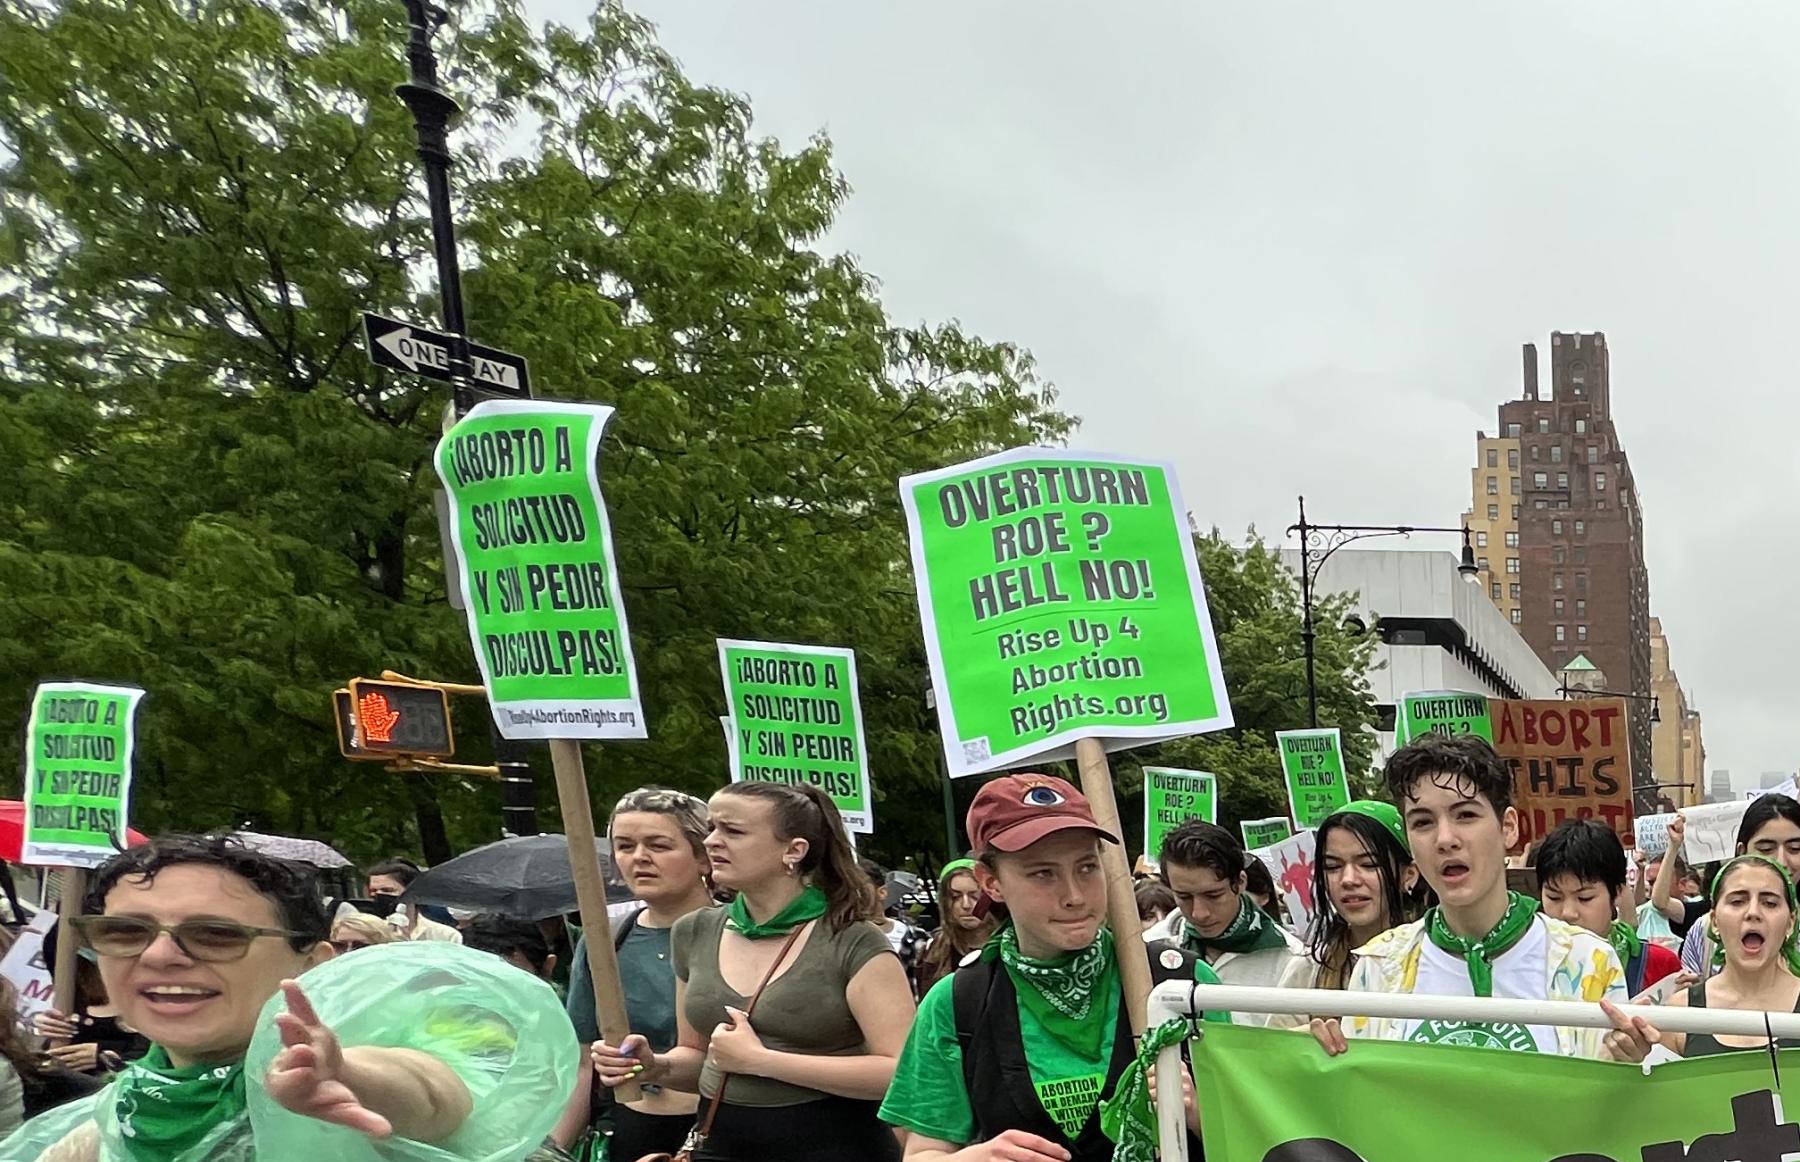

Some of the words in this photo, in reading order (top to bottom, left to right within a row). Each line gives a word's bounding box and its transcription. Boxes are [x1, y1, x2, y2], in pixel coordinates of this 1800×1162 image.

[399, 337, 449, 371] ONE
[555, 426, 572, 473] A
[937, 467, 1149, 528] OVERTURN
[471, 493, 587, 550] SOLICITUD
[991, 512, 1071, 565] ROE
[1081, 512, 1109, 551] ?
[473, 570, 489, 615] Y
[496, 567, 525, 615] SIN
[526, 561, 609, 612] PEDIR
[968, 563, 1070, 622] HELL
[1079, 559, 1155, 602] NO!
[486, 628, 622, 679] DISCULPAS!
[997, 628, 1060, 660] Rise
[1068, 618, 1109, 649] Up
[1118, 616, 1139, 640] 4
[736, 656, 816, 688] ¡ABORTO
[824, 663, 839, 690] A
[1011, 651, 1142, 696] Abortion
[104, 700, 118, 726] A
[743, 693, 841, 726] SOLICITUD
[1009, 692, 1169, 737] Rights.org
[1413, 698, 1485, 721] OVERTURN
[1500, 706, 1618, 752] ABORT
[741, 729, 751, 755] Y
[758, 730, 786, 758] SIN
[792, 733, 855, 763] PEDIR
[36, 771, 47, 796] Y
[1153, 774, 1208, 795] OVERTURN
[1503, 755, 1618, 797] THIS
[1164, 792, 1184, 809] ROE
[1185, 795, 1195, 810] ?
[1507, 799, 1636, 851] OURT!
[1040, 1076, 1099, 1099] ABORTION
[1043, 1098, 1059, 1110] ON
[1059, 1091, 1100, 1107] DEMAND
